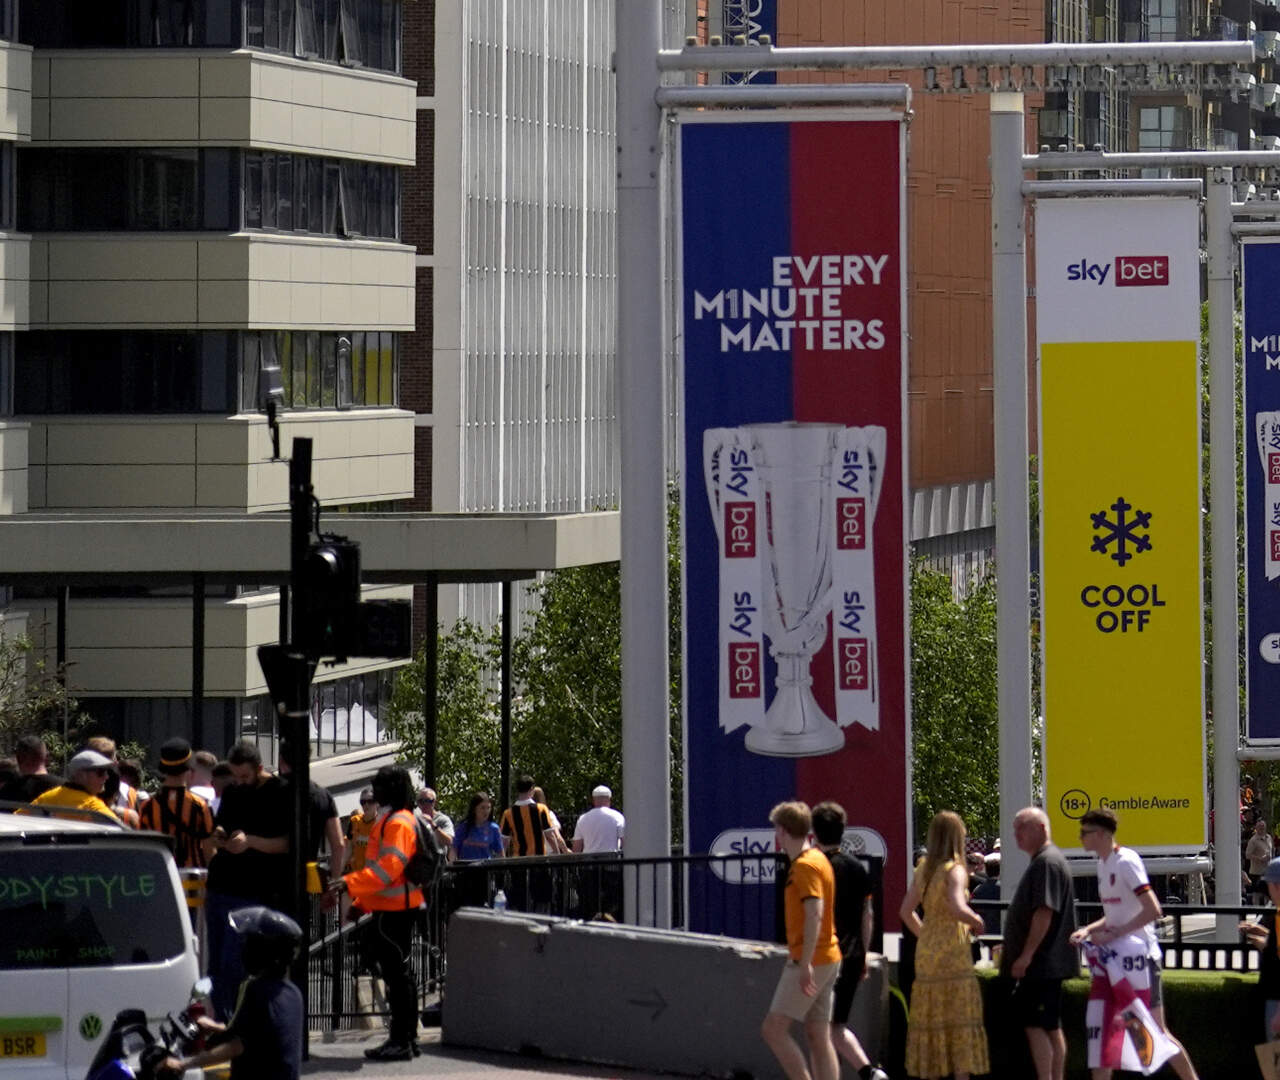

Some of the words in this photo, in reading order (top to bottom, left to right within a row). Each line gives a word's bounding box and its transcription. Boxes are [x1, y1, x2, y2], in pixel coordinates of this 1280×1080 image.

[773, 255, 888, 286] EVERY
[1067, 259, 1111, 285] sky
[1121, 259, 1164, 280] bet
[721, 319, 885, 352] MATTERS
[726, 449, 753, 497] sky
[838, 450, 863, 493] sky
[731, 507, 752, 552] bet
[843, 503, 862, 544] bet
[729, 591, 757, 637] sky
[839, 591, 865, 633] sky
[1080, 584, 1166, 608] COOL
[1096, 610, 1151, 633] OFF
[735, 648, 756, 693] bet
[845, 643, 865, 685] bet
[1099, 797, 1190, 810] GambleAware
